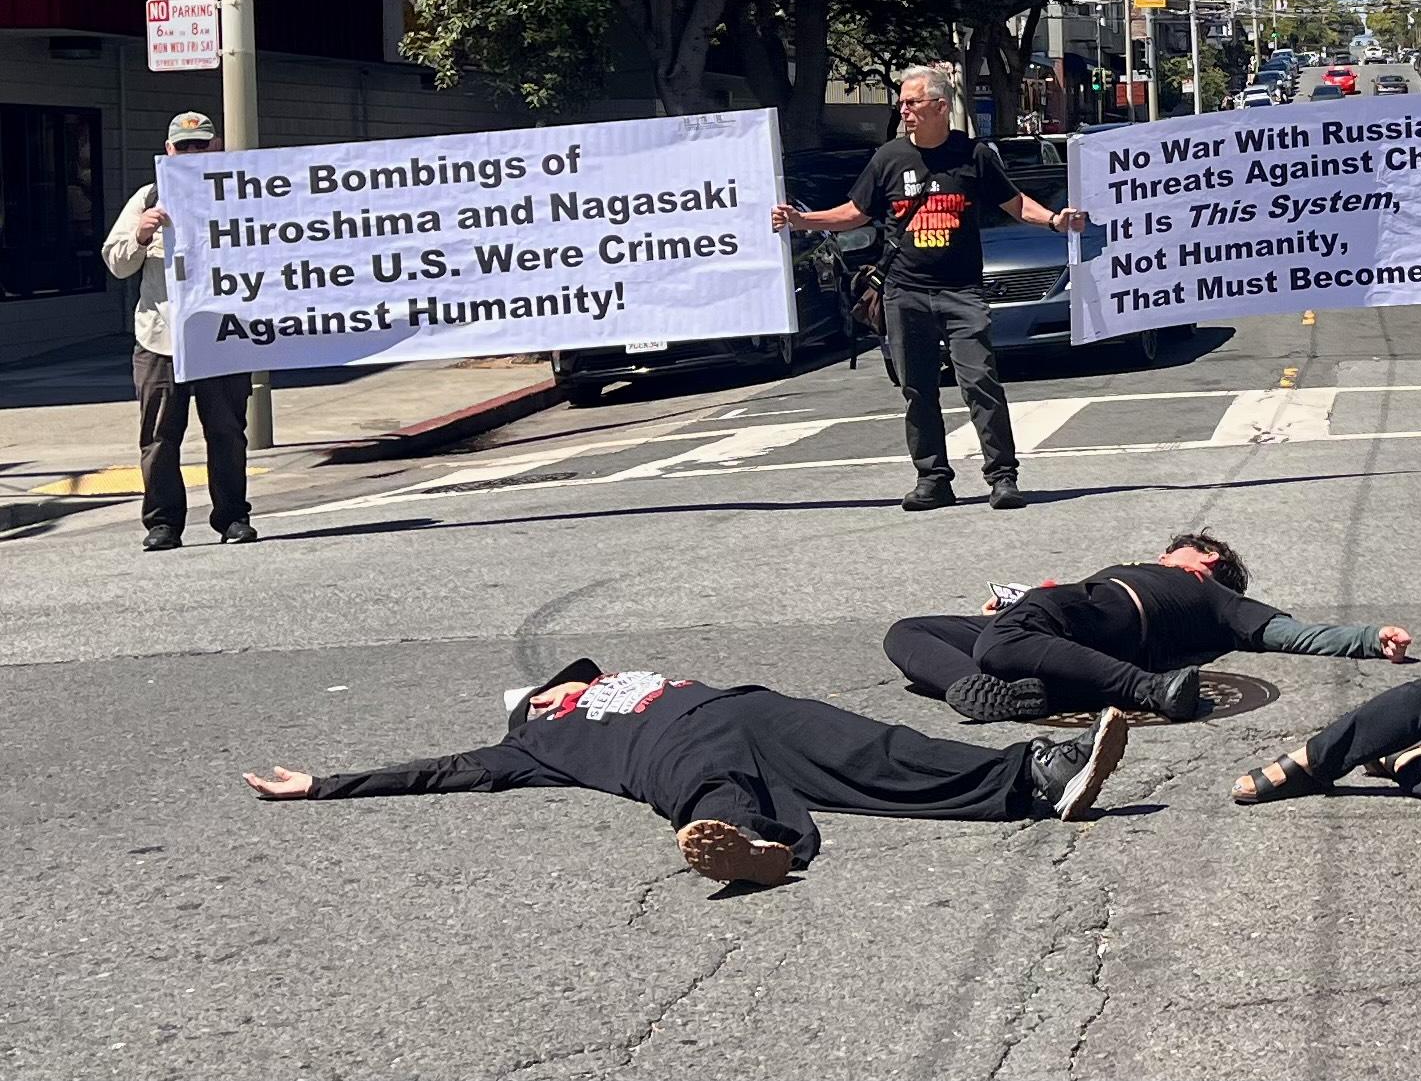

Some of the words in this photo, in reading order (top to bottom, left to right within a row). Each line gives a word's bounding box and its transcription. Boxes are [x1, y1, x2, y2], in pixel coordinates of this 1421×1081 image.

[149, 1, 167, 20] NO
[172, 4, 213, 19] PARKING
[153, 42, 168, 53] MON
[171, 42, 185, 53] WED
[201, 40, 214, 52] SAT
[204, 171, 291, 200] The
[310, 156, 526, 194] Bombings
[542, 145, 580, 175] of
[1110, 148, 1150, 174] No
[1161, 138, 1225, 164] War
[1235, 126, 1309, 153] With
[1109, 166, 1233, 204] Threats
[1245, 150, 1373, 187] Against
[210, 209, 440, 248] Hiroshima
[458, 196, 533, 229] and
[551, 179, 737, 224] Nagasaki
[914, 229, 950, 248] LESS!
[1111, 217, 1132, 242] It
[1145, 213, 1172, 235] Is
[1189, 200, 1257, 228] This
[1268, 190, 1400, 223] System,
[212, 268, 264, 301] by
[281, 260, 354, 290] the
[373, 250, 460, 282] U.S.
[475, 244, 583, 274] Were
[599, 233, 737, 264] Crimes
[1112, 248, 1167, 278] Not
[1179, 229, 1347, 266] Humanity,
[216, 302, 392, 345] Against
[408, 282, 624, 326] Humanity!
[1111, 282, 1185, 314] That
[1197, 271, 1277, 301] Must
